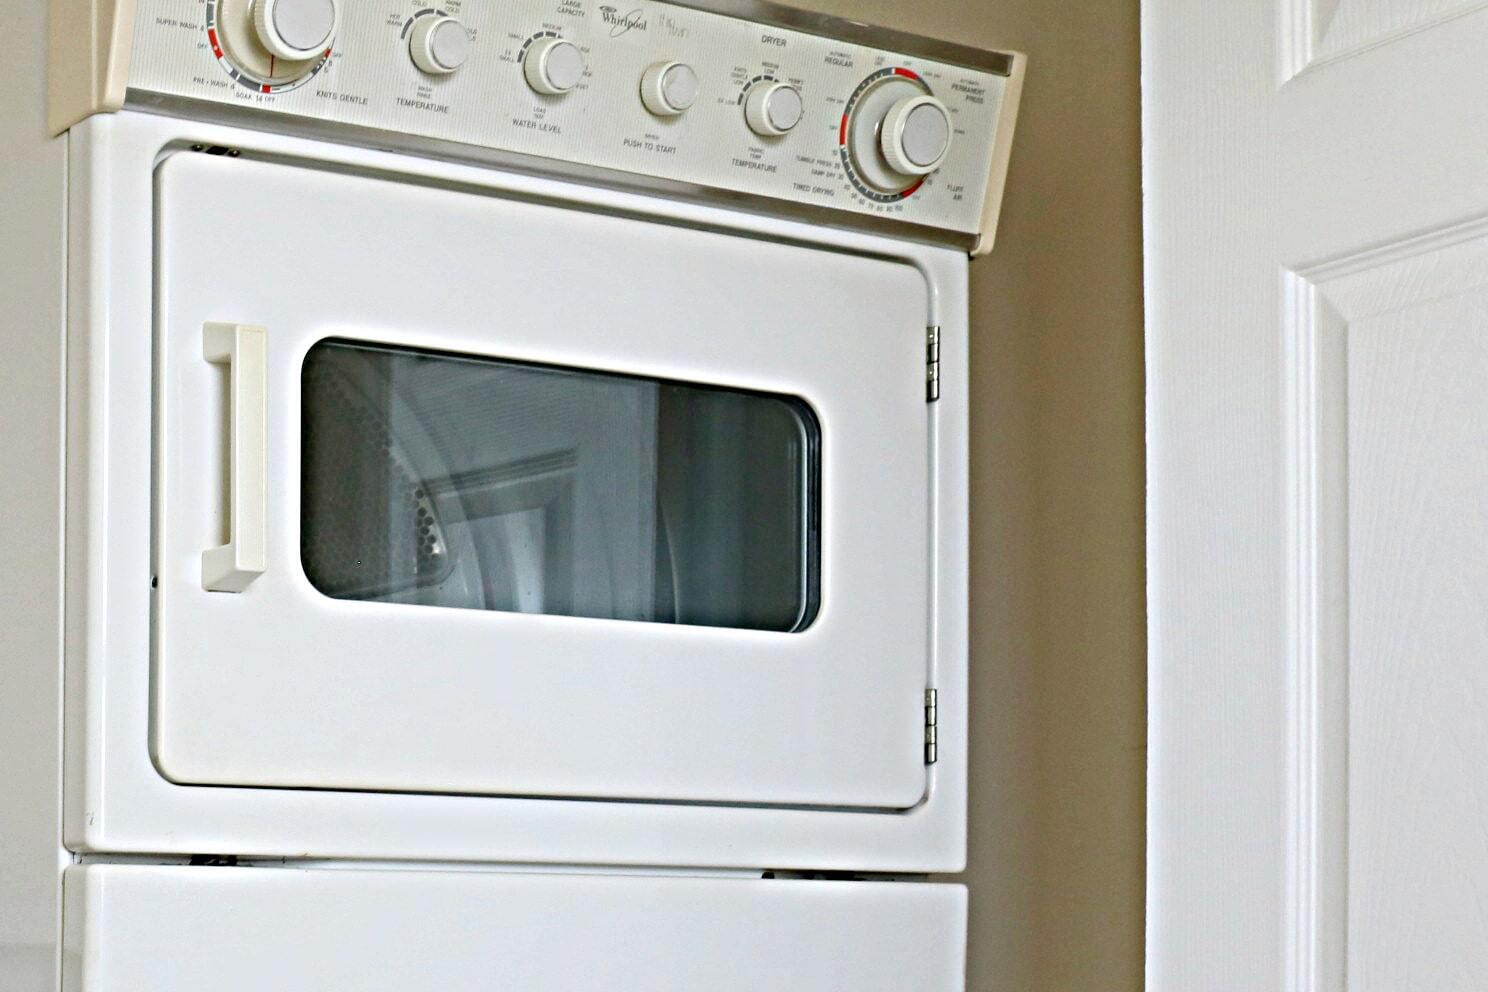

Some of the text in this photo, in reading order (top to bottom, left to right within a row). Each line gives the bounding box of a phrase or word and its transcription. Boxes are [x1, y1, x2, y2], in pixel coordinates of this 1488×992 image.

[155, 17, 177, 27] SUPER
[179, 21, 197, 30] WASH
[602, 11, 647, 32] Whirlpool
[761, 35, 787, 47] DRYER
[340, 93, 368, 105] GENTLE
[396, 97, 449, 114] TEMPERATURE
[512, 118, 561, 134] WATER LEVEL
[623, 138, 677, 154] PUSH TO START
[731, 158, 777, 173] TEMPERATURE
[793, 182, 810, 193] TIMED
